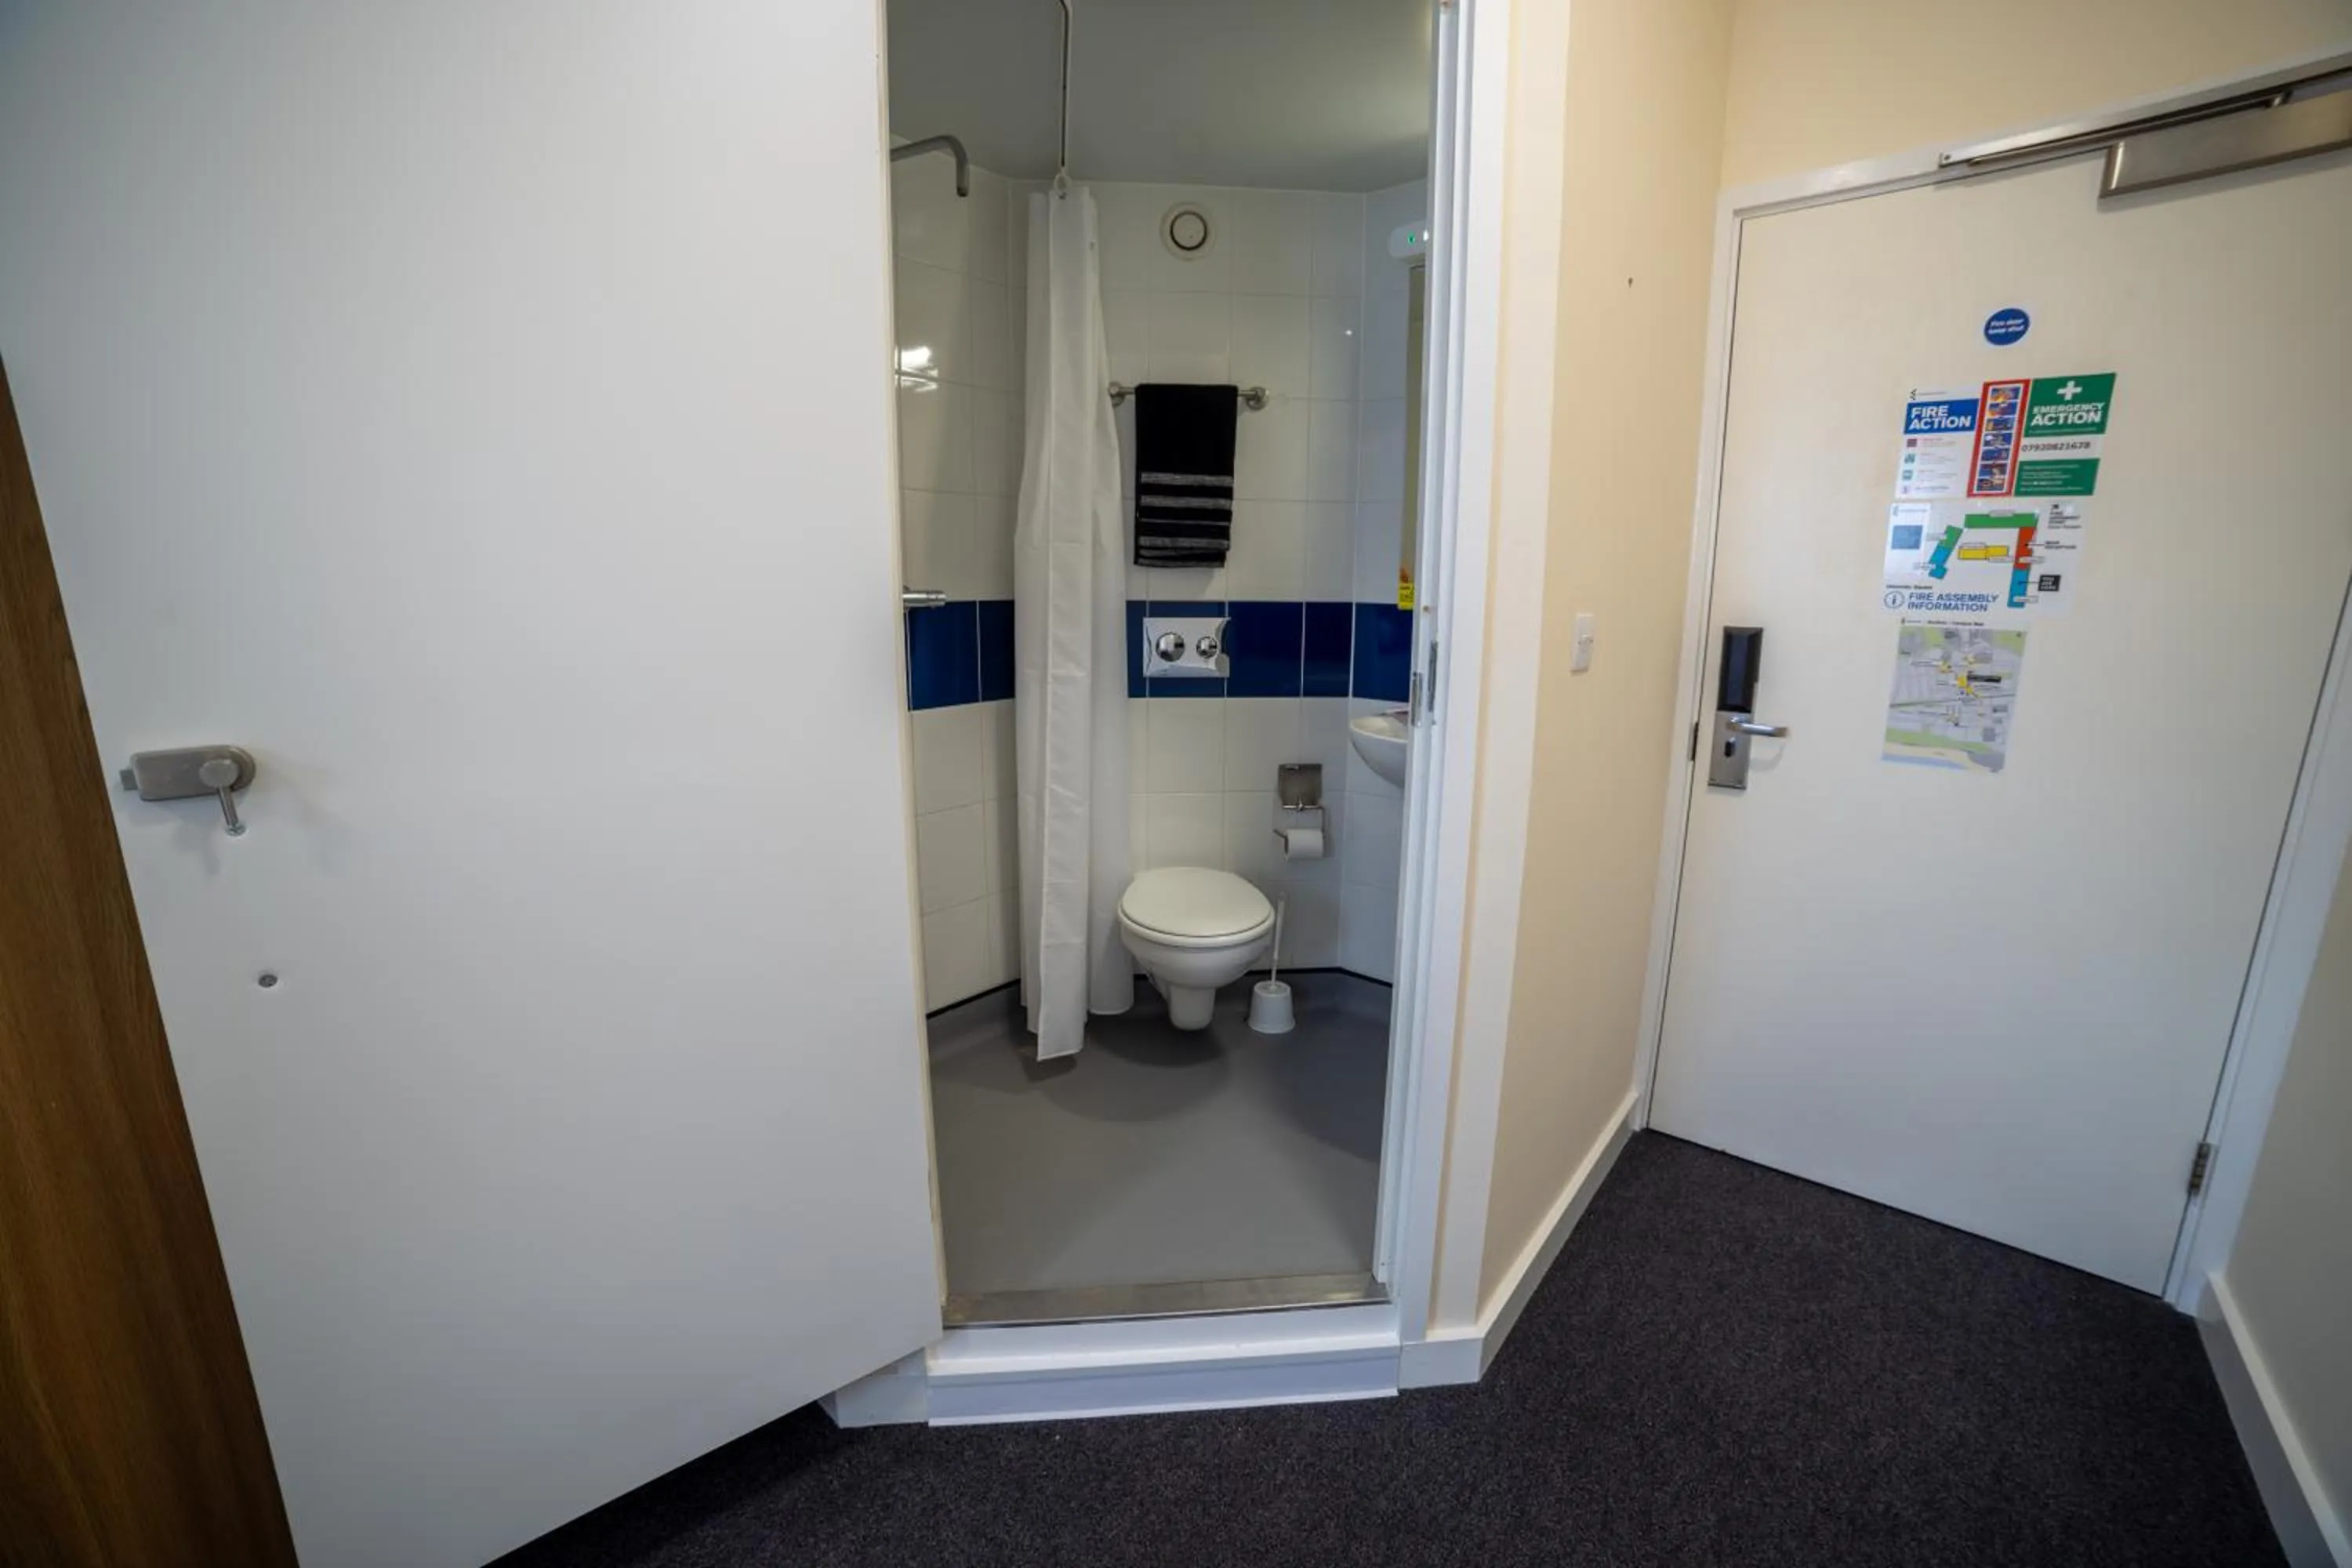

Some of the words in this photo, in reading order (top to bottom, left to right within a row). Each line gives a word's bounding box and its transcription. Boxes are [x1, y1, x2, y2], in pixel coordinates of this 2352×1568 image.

[1911, 405, 1949, 419] FIRE
[2032, 402, 2106, 415] EMERGENCY
[1908, 416, 1972, 430] ACTION
[2030, 410, 2103, 427] ACTION
[1908, 592, 1933, 601] FIRE
[1936, 593, 1999, 603] ASSEMBLY
[1907, 601, 1988, 612] INFORMATION
